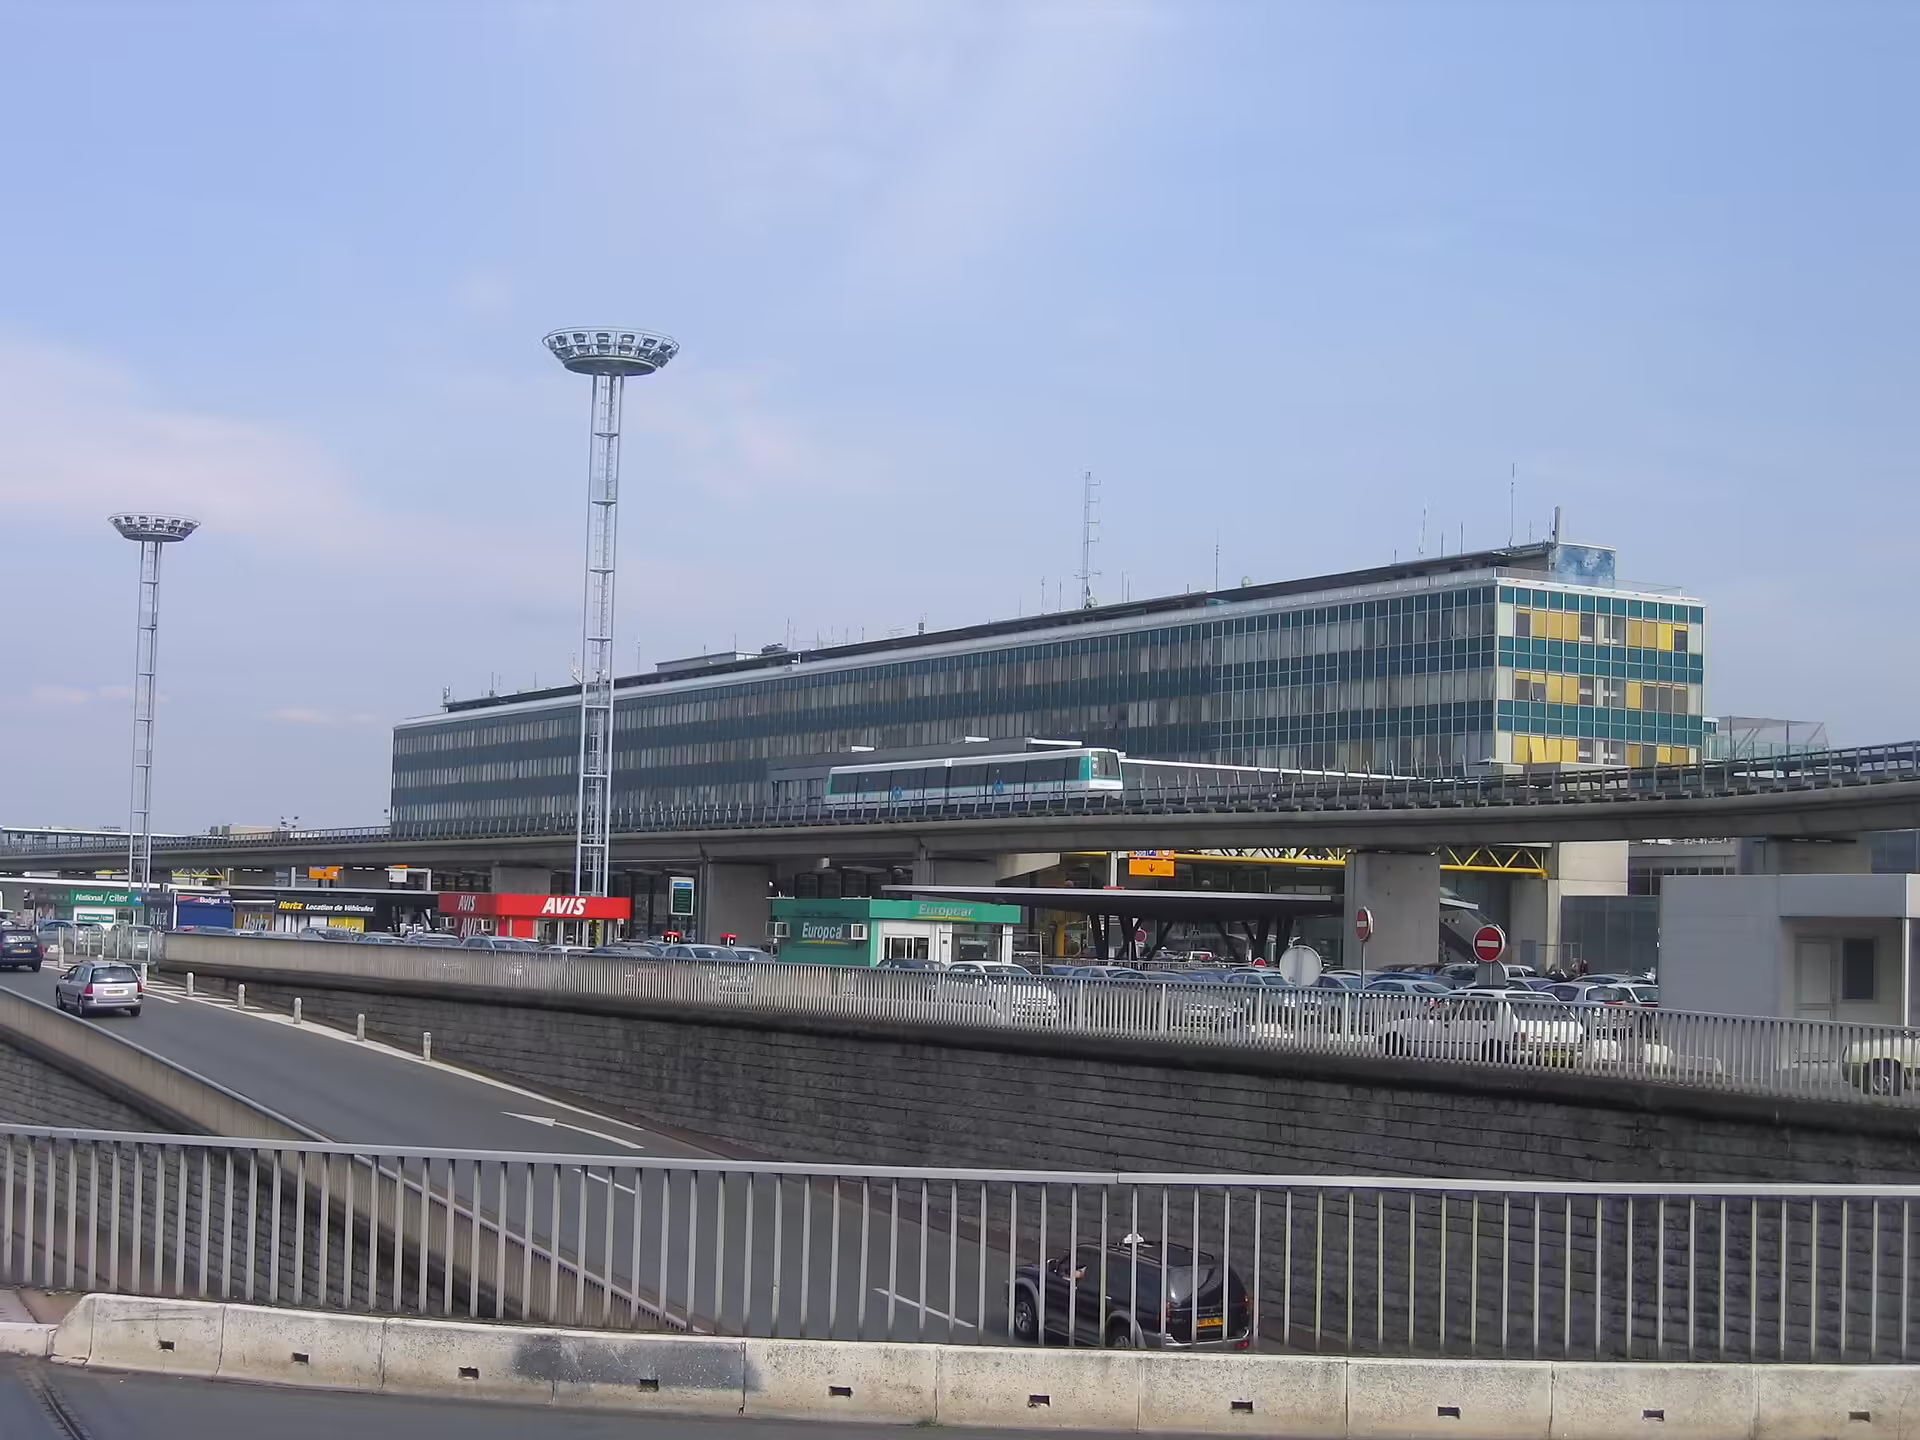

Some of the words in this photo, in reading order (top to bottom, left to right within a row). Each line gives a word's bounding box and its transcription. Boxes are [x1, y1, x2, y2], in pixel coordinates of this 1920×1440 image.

[199, 896, 220, 905] Budget
[279, 901, 303, 909] Hertz
[458, 895, 475, 911] AVIS
[541, 897, 587, 915] AVIS
[918, 903, 974, 917] Europcar
[802, 922, 843, 943] Europca
